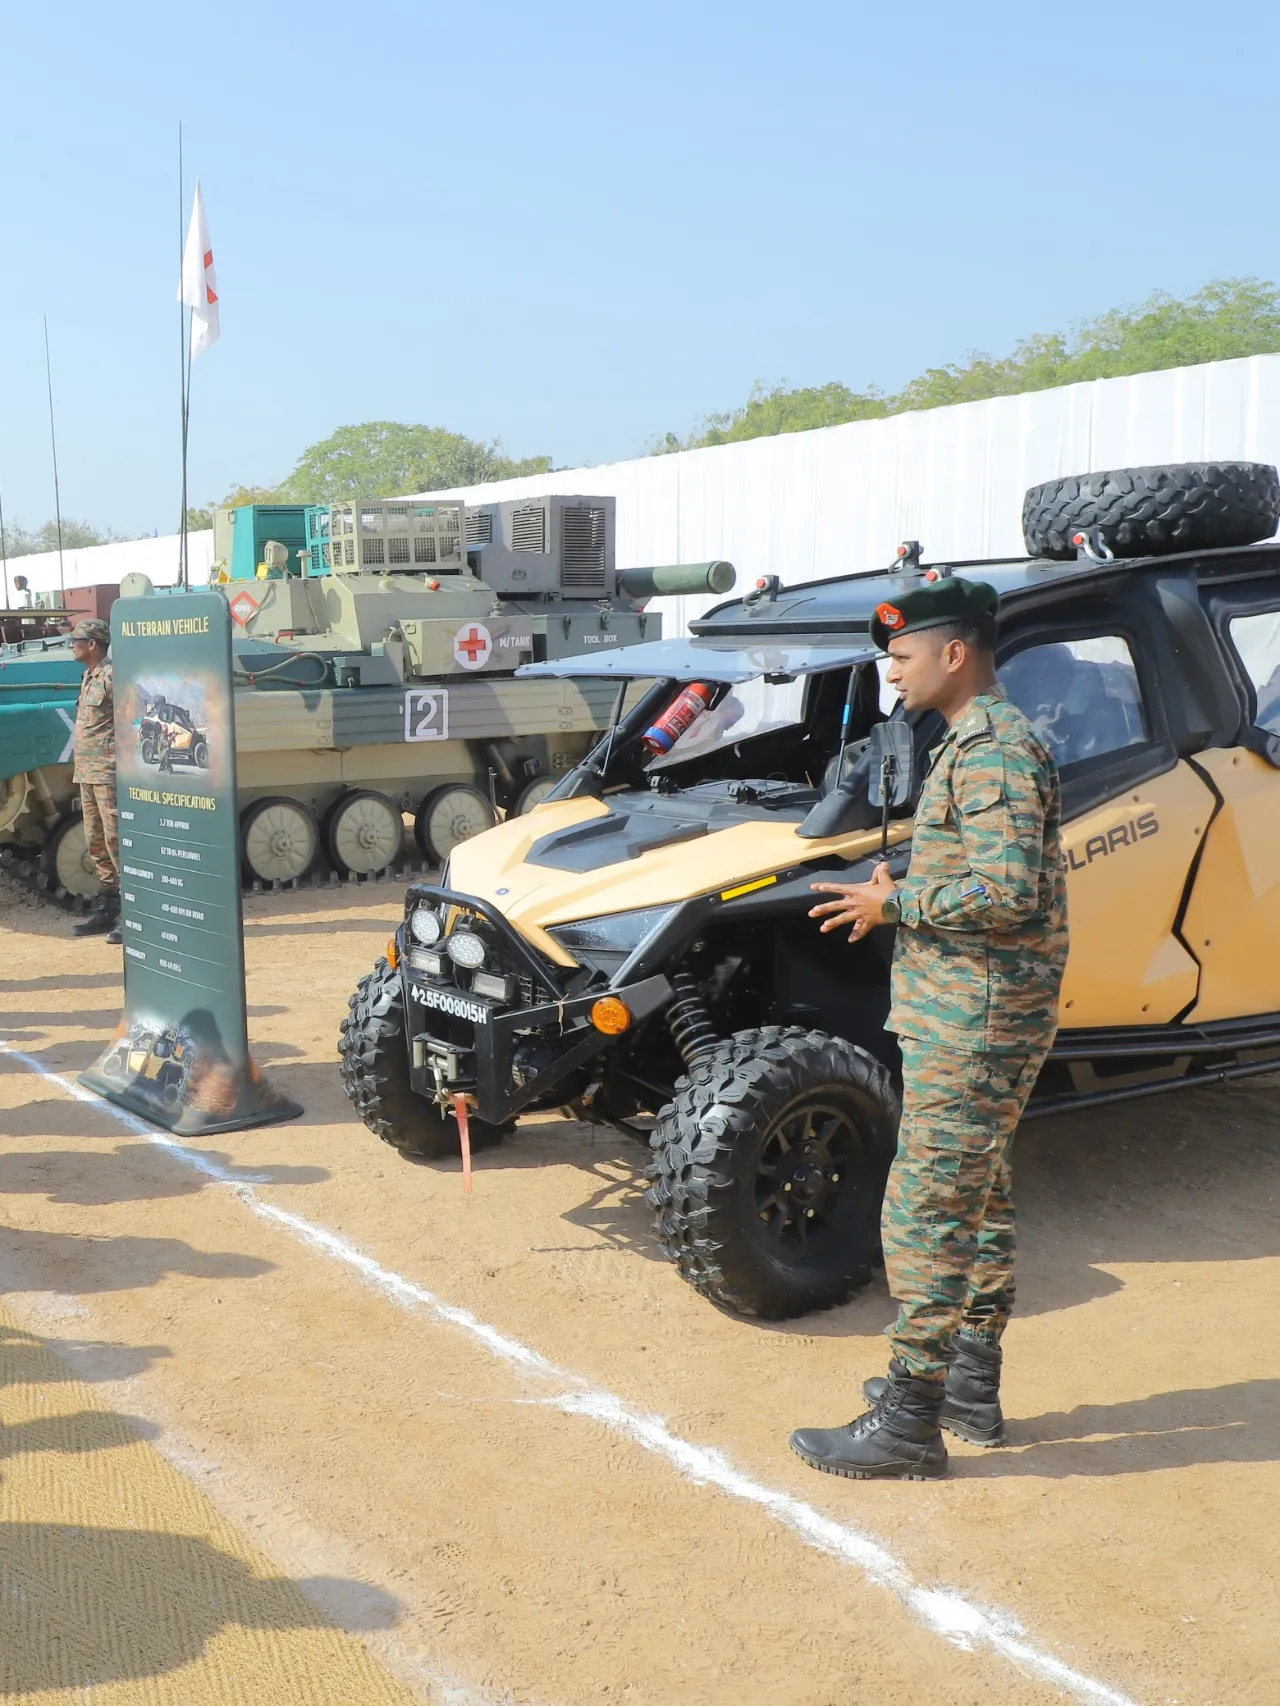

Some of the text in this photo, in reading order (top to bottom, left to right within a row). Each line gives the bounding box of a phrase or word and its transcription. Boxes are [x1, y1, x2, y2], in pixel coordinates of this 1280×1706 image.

[121, 616, 209, 637] ALL TERRAIN VEHICLE
[499, 636, 531, 648] W/TANK
[583, 634, 618, 644] TOOL BOX
[415, 695, 438, 737] 2
[128, 787, 216, 811] TECHNICAL SPECIFICATIONS
[419, 988, 488, 1025] 25F008015H
